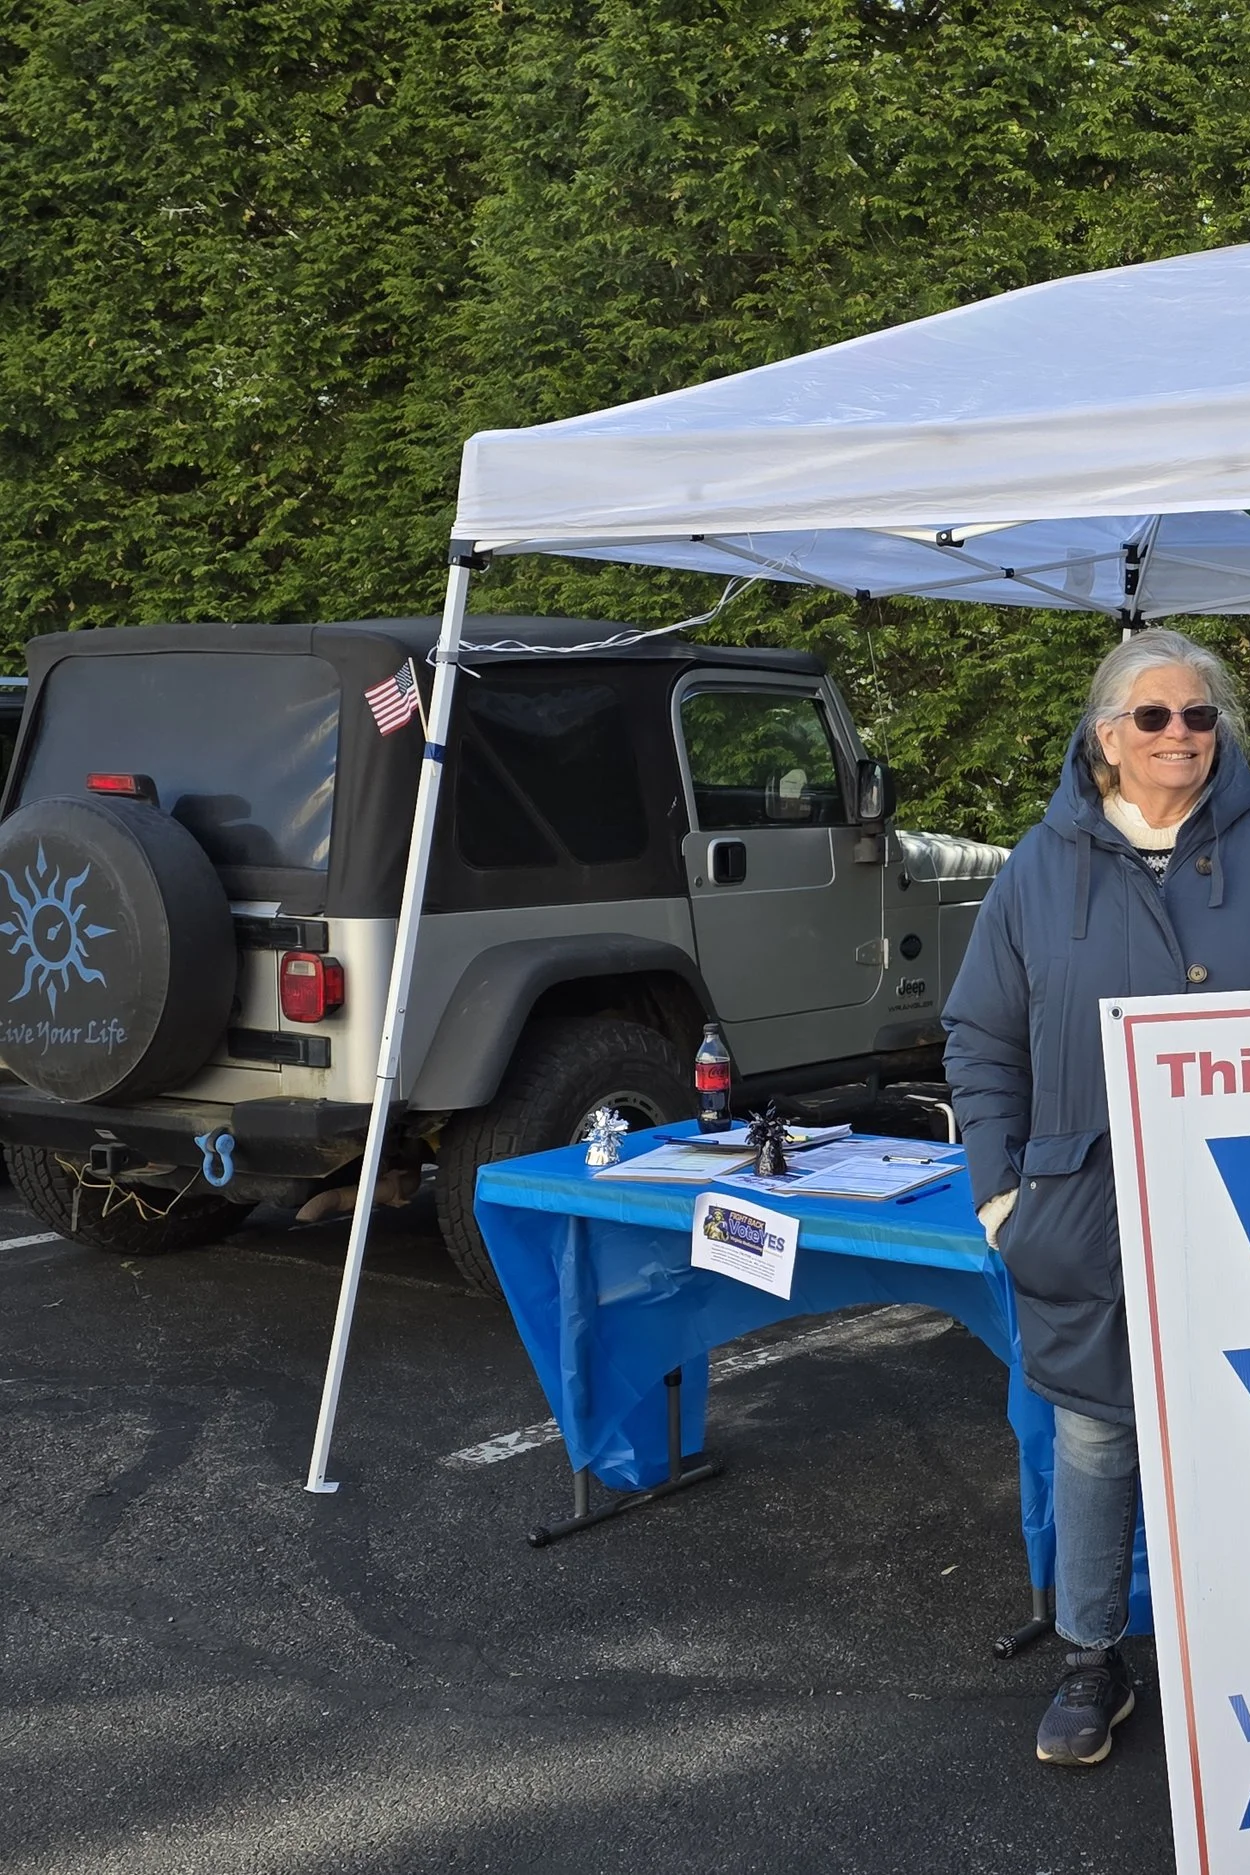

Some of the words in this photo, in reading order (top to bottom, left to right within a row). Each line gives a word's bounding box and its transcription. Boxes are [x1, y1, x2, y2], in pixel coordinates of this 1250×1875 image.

[896, 977, 925, 998] Jeep
[888, 1000, 934, 1012] WRANGLER
[36, 1020, 82, 1056] Your
[84, 1018, 128, 1055] Life
